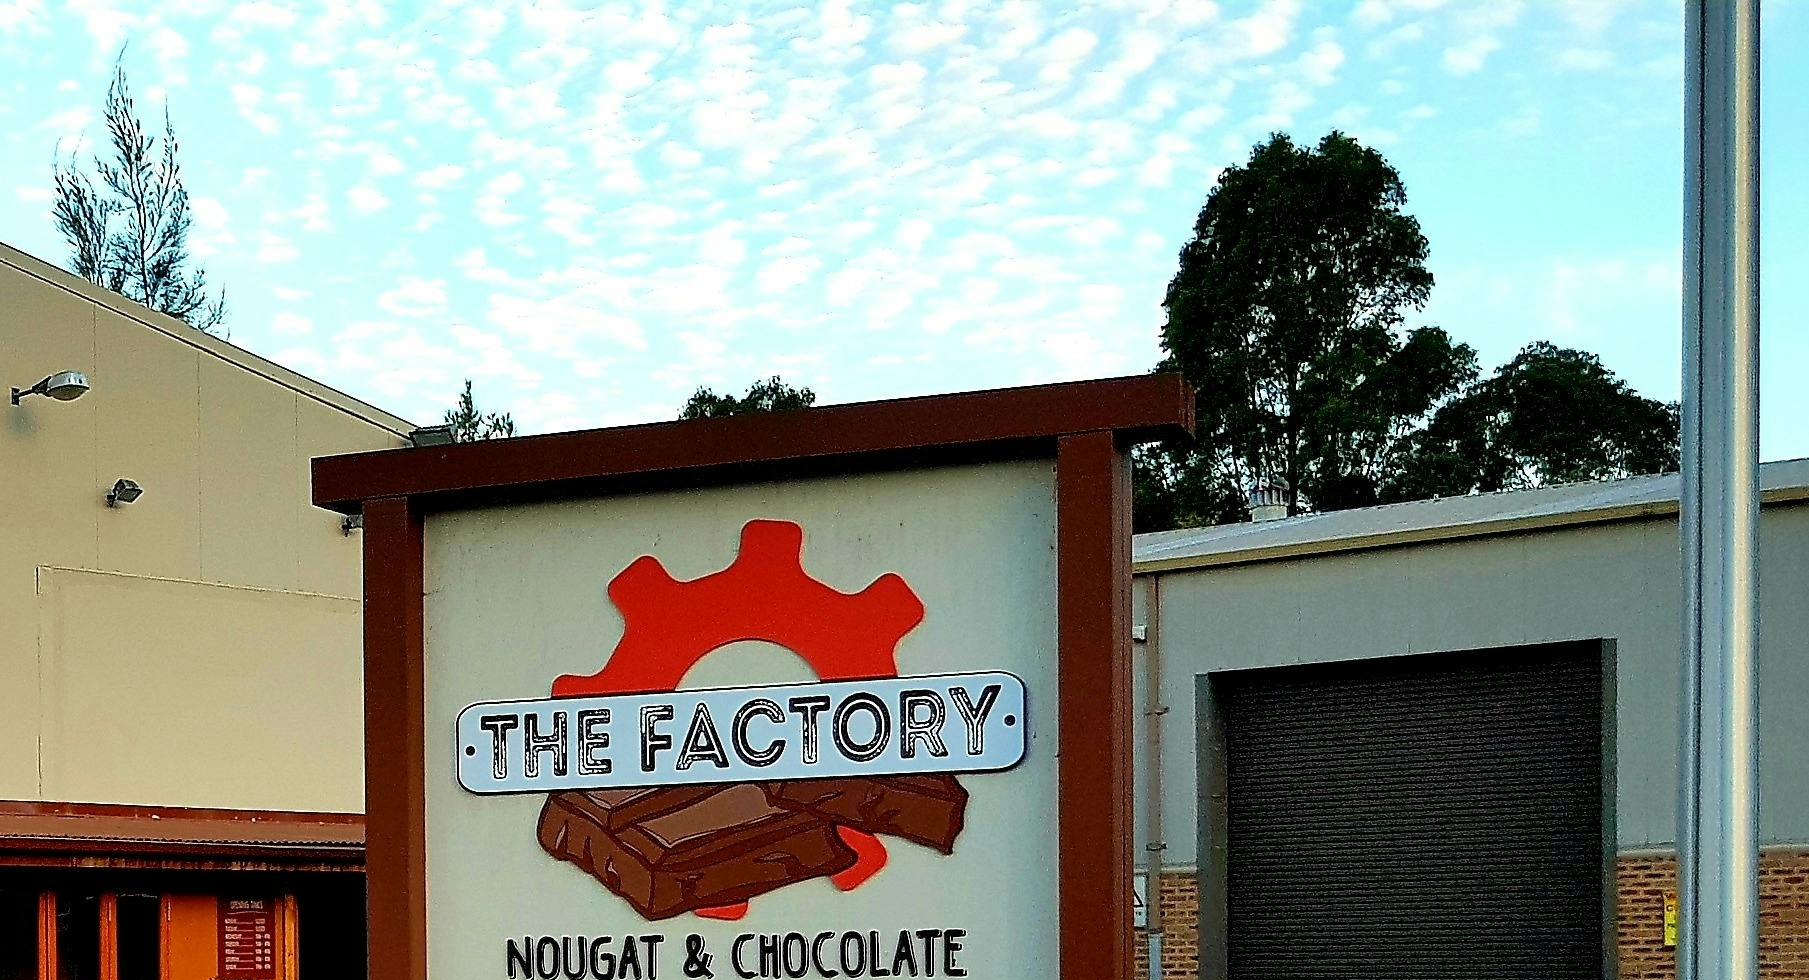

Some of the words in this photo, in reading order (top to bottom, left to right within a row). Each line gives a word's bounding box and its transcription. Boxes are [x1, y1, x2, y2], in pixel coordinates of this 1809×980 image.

[481, 708, 613, 780] THE
[639, 684, 1002, 772] FACTORY
[685, 933, 714, 979] &
[732, 928, 969, 980] CHOCOLATE
